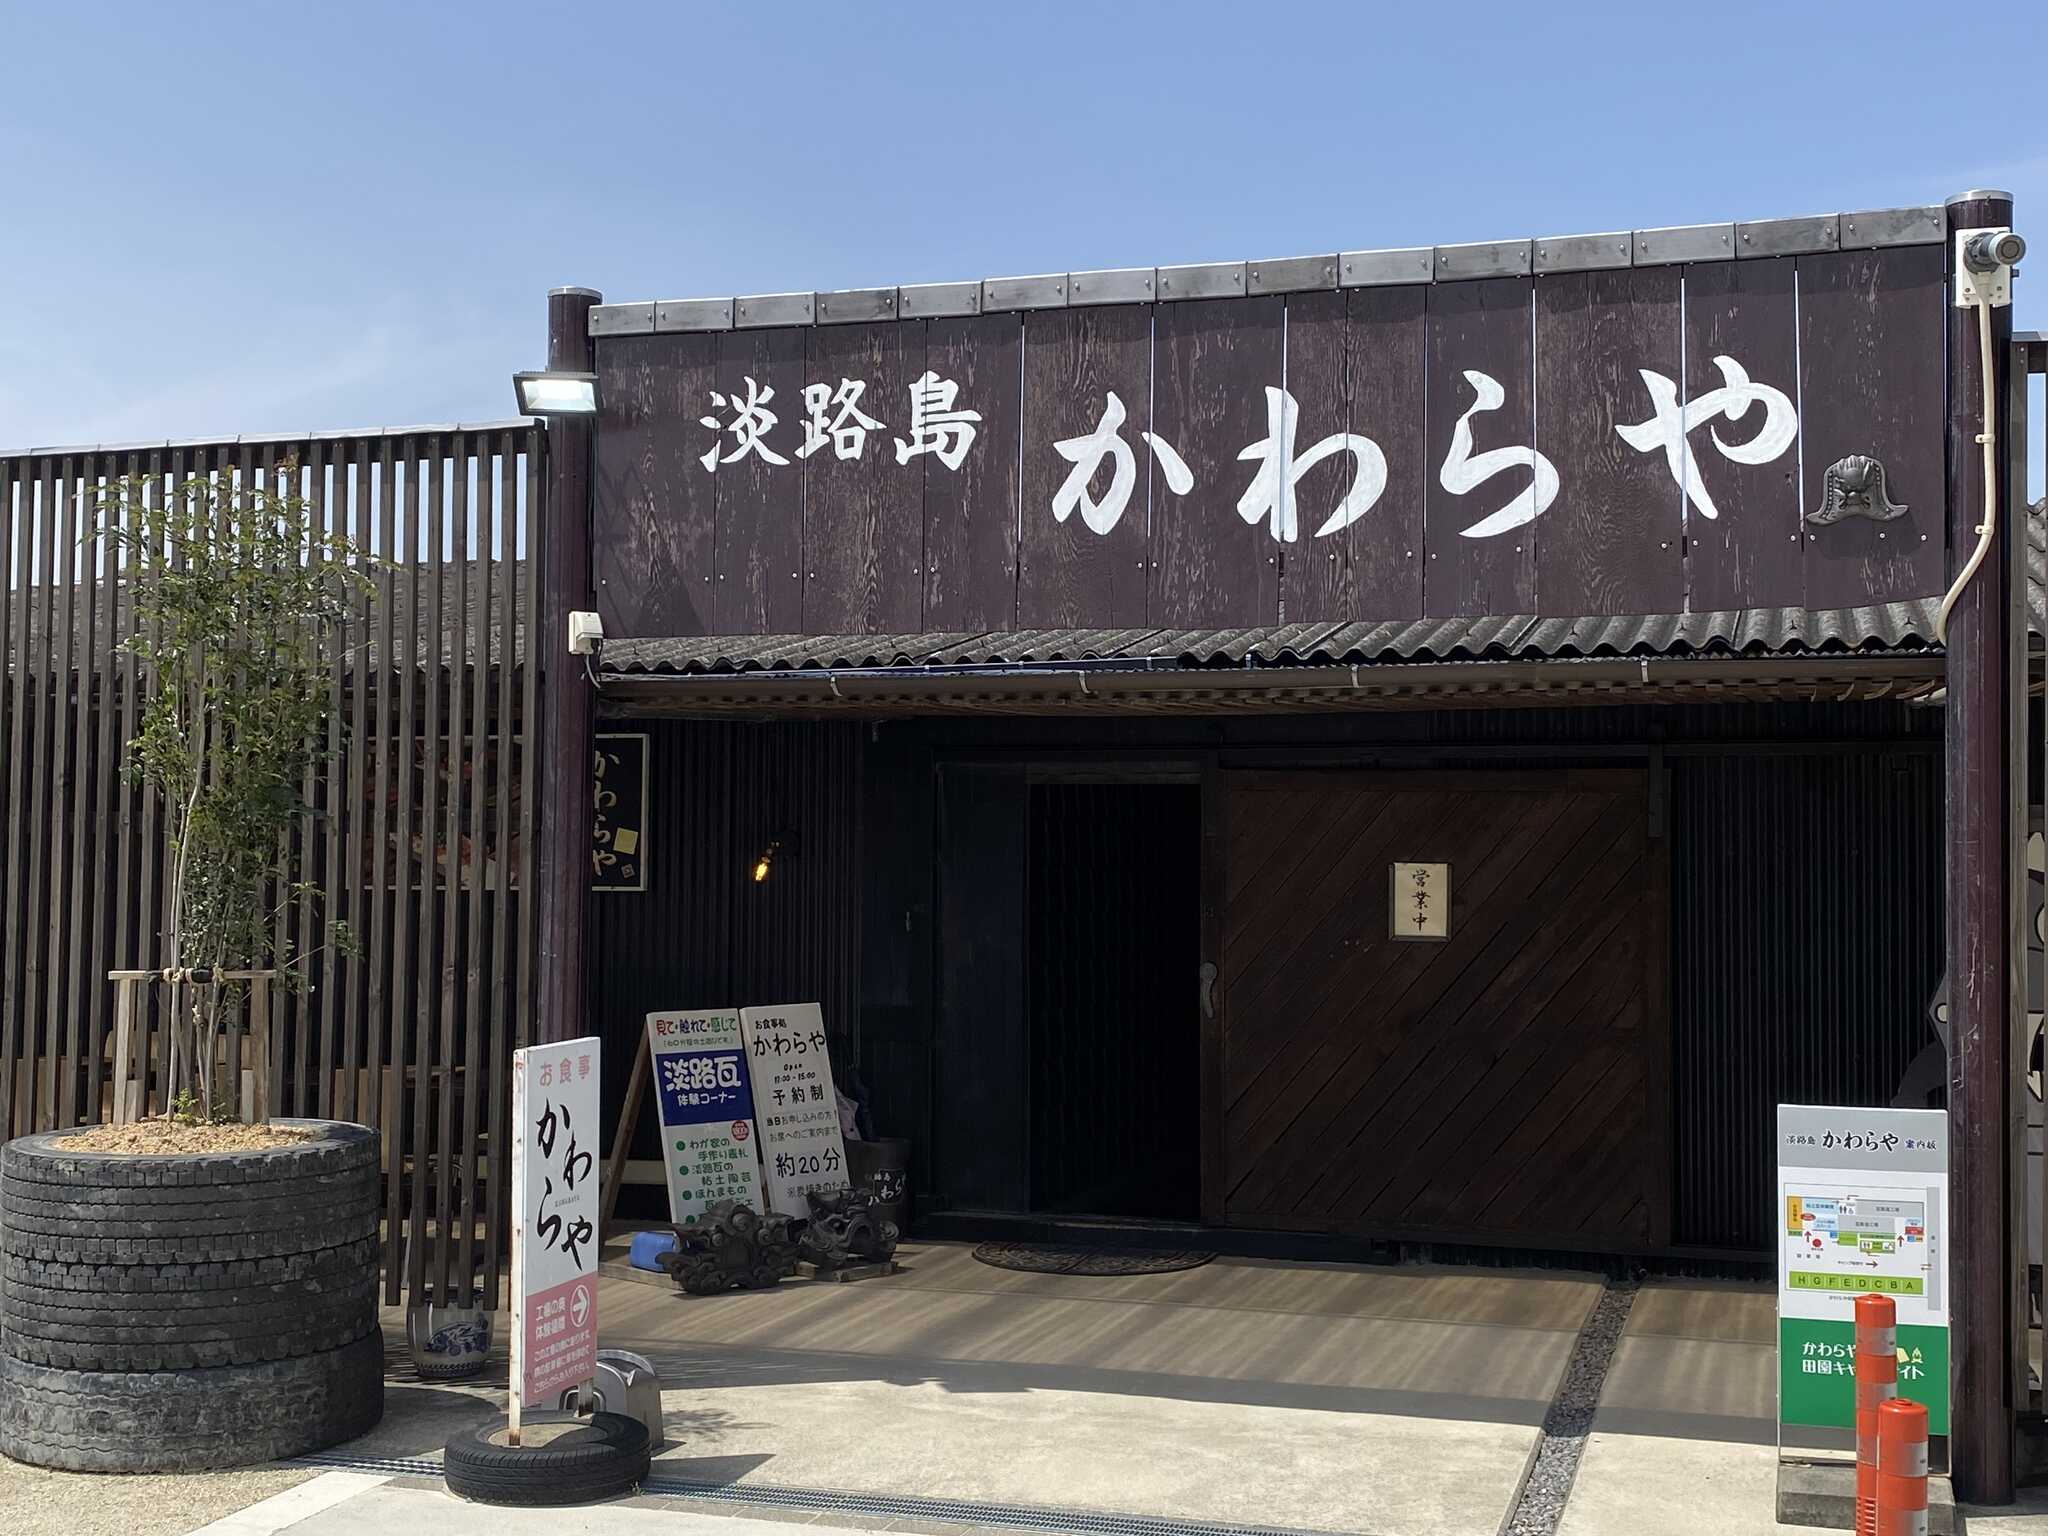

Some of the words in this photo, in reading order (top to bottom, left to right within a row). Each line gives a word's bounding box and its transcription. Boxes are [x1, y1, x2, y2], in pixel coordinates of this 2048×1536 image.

[699, 370, 983, 473] 淡路島
[1052, 354, 1799, 544] かわらや
[1411, 868, 1431, 932] 営業中
[753, 1030, 826, 1057] かわらや
[539, 1055, 592, 1088] お食事
[663, 1055, 742, 1092] 淡路瓦
[677, 1091, 737, 1107] 体験コーナー
[772, 1083, 824, 1106] 予約制
[1822, 1130, 1899, 1152] かわらや
[775, 1146, 841, 1179] 約20分
[535, 1096, 594, 1272] かわらや
[1798, 1276, 1806, 1285] H
[1844, 1278, 1851, 1287] E
[1858, 1279, 1867, 1288] D
[1874, 1280, 1883, 1288] C
[1890, 1281, 1898, 1289] B
[1906, 1282, 1914, 1290] A
